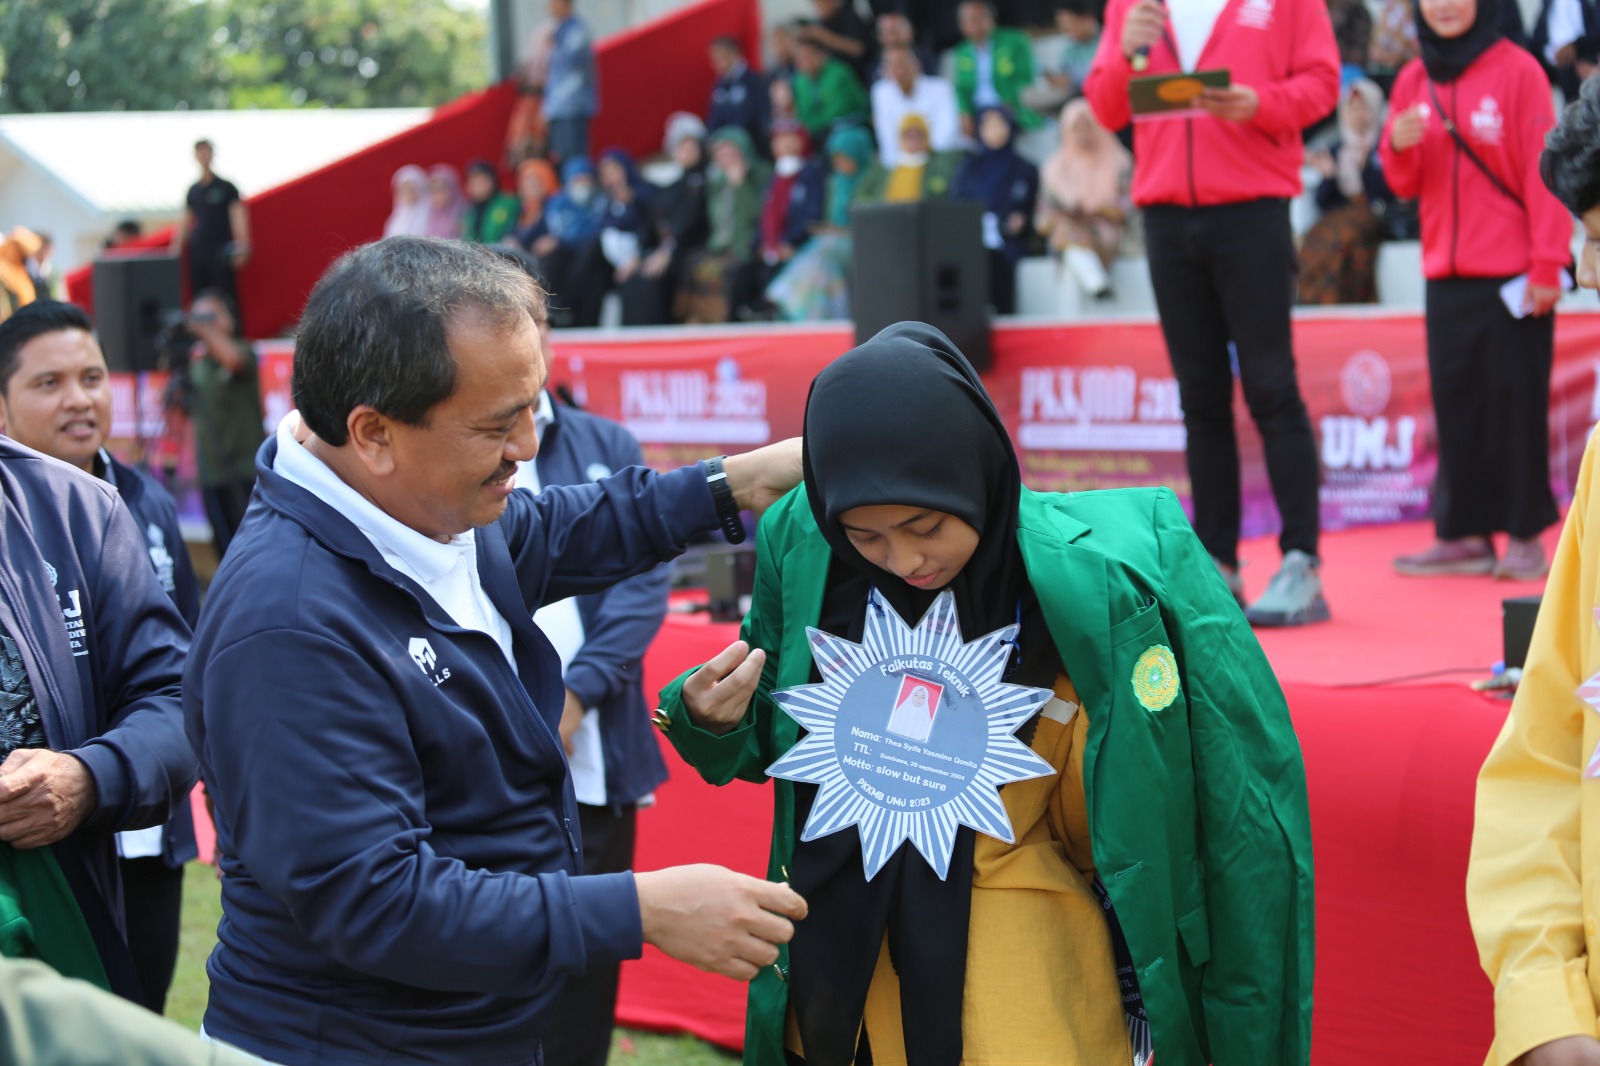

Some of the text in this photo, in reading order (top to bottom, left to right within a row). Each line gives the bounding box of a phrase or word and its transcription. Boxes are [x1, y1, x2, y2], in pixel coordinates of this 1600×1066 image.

[1321, 416, 1415, 469] UMJ
[880, 657, 970, 698] Falkutas Teknik
[850, 726, 882, 743] Nama:
[853, 742, 873, 756] TTL:
[842, 754, 947, 792] Motto: slow but sure
[856, 777, 931, 808] PKKMB UMJ 2023
